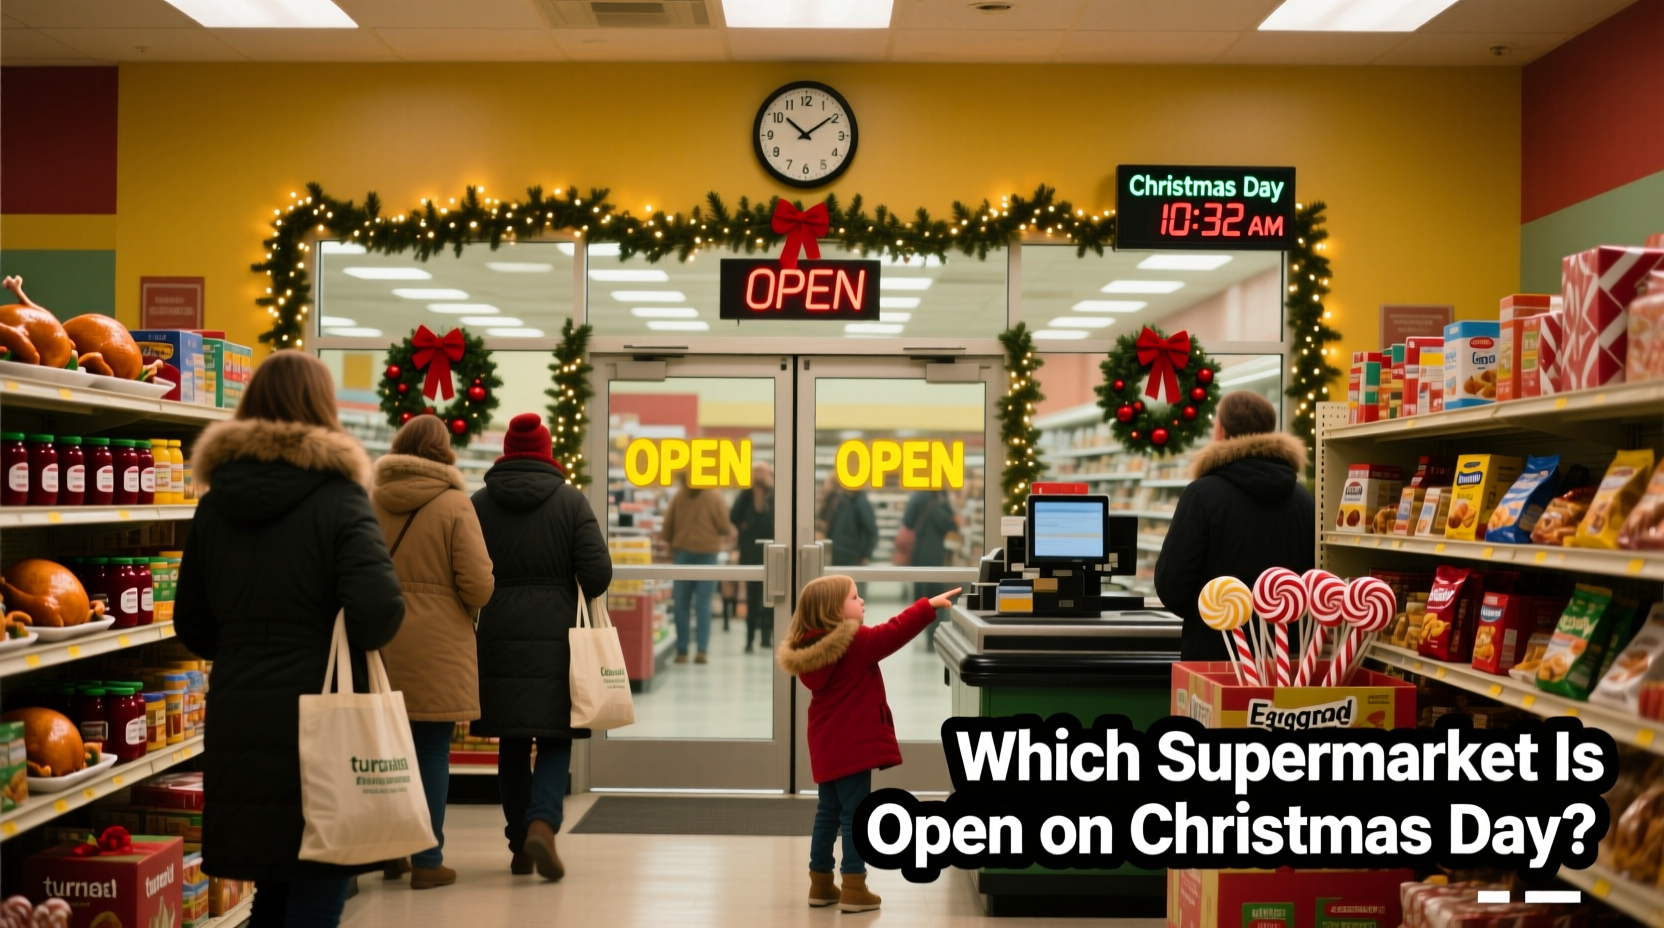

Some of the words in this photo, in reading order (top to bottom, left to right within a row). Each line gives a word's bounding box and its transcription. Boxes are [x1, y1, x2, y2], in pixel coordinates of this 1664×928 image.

[785, 99, 794, 111] 11
[801, 95, 813, 107] 12
[773, 112, 784, 123] 10
[831, 113, 839, 124] 2
[767, 130, 774, 140] 9
[838, 131, 845, 141] 3
[773, 146, 780, 157] 8
[831, 147, 838, 157] 4
[786, 159, 793, 170] 7
[802, 163, 810, 175] 6
[820, 159, 827, 170] 5
[1129, 174, 1237, 197] Christmas
[1243, 175, 1285, 204] Day
[1160, 202, 1245, 237] 10:32
[1247, 215, 1284, 237] AM
[745, 267, 866, 311] OPEN
[625, 437, 752, 488] OPEN
[835, 439, 965, 490] OPEN
